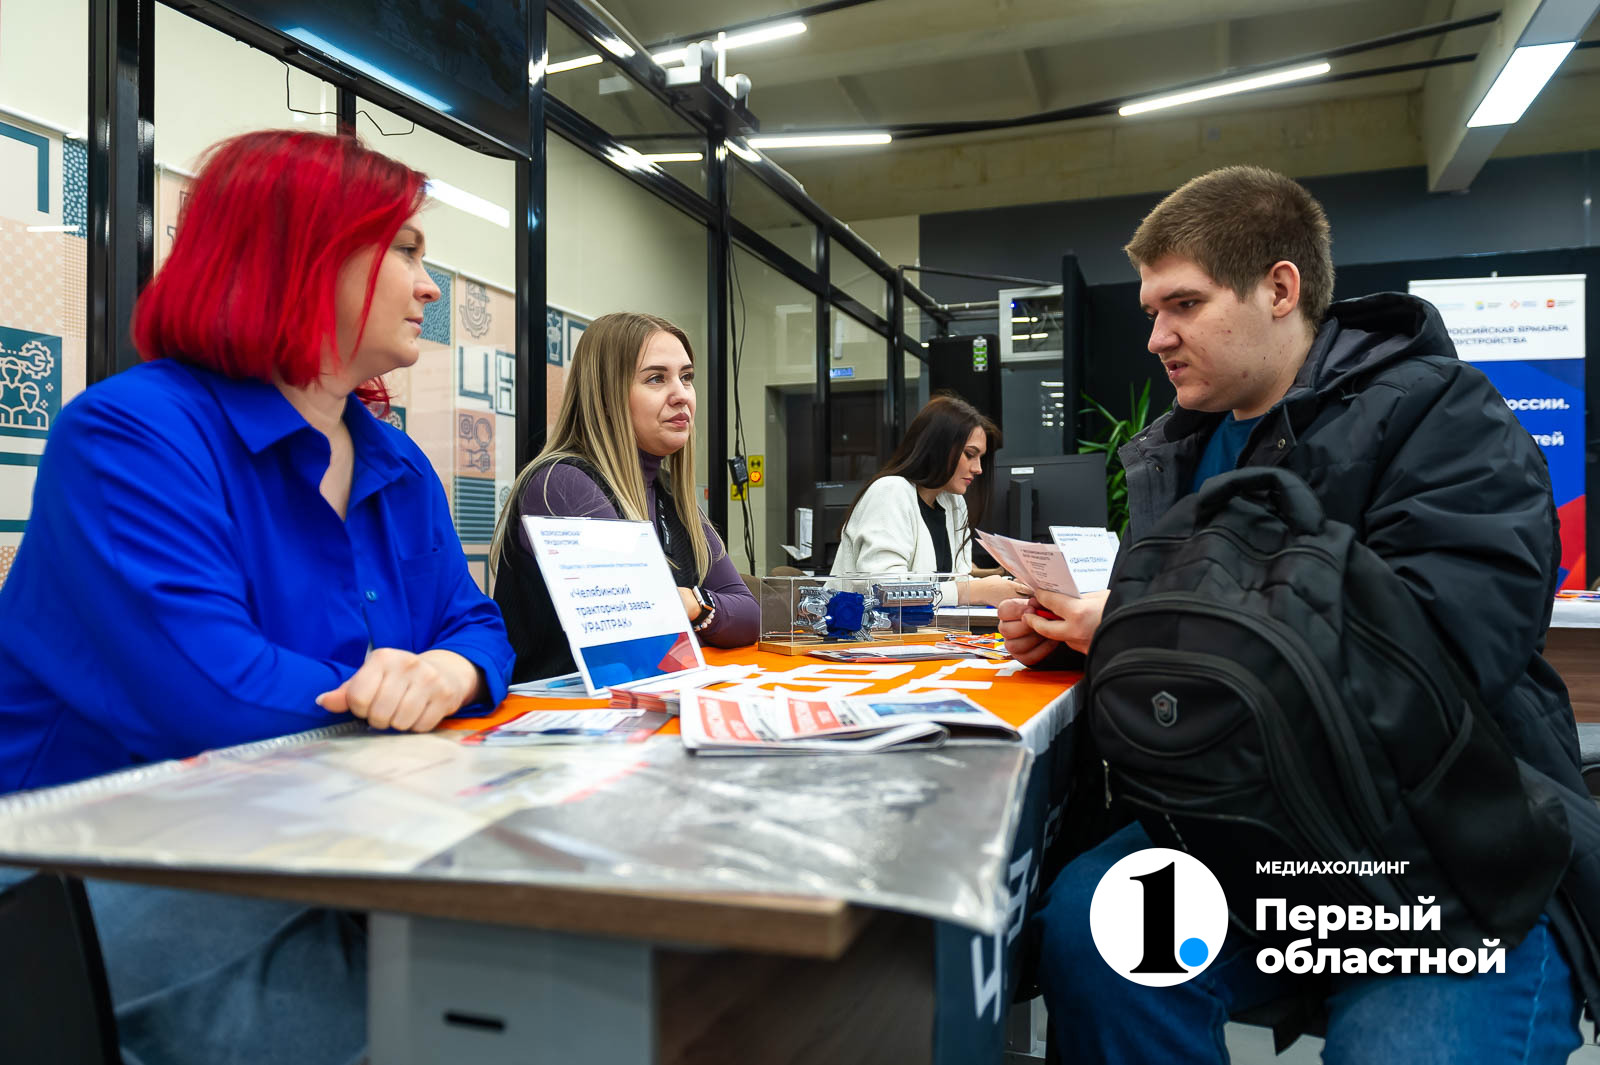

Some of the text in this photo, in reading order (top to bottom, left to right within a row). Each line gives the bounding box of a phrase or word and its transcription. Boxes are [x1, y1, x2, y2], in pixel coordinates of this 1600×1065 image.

[570, 584, 631, 598] «Челябинский
[576, 601, 627, 617] тракторный
[628, 601, 651, 611] завод
[581, 618, 632, 634] УРАЛТРАК»
